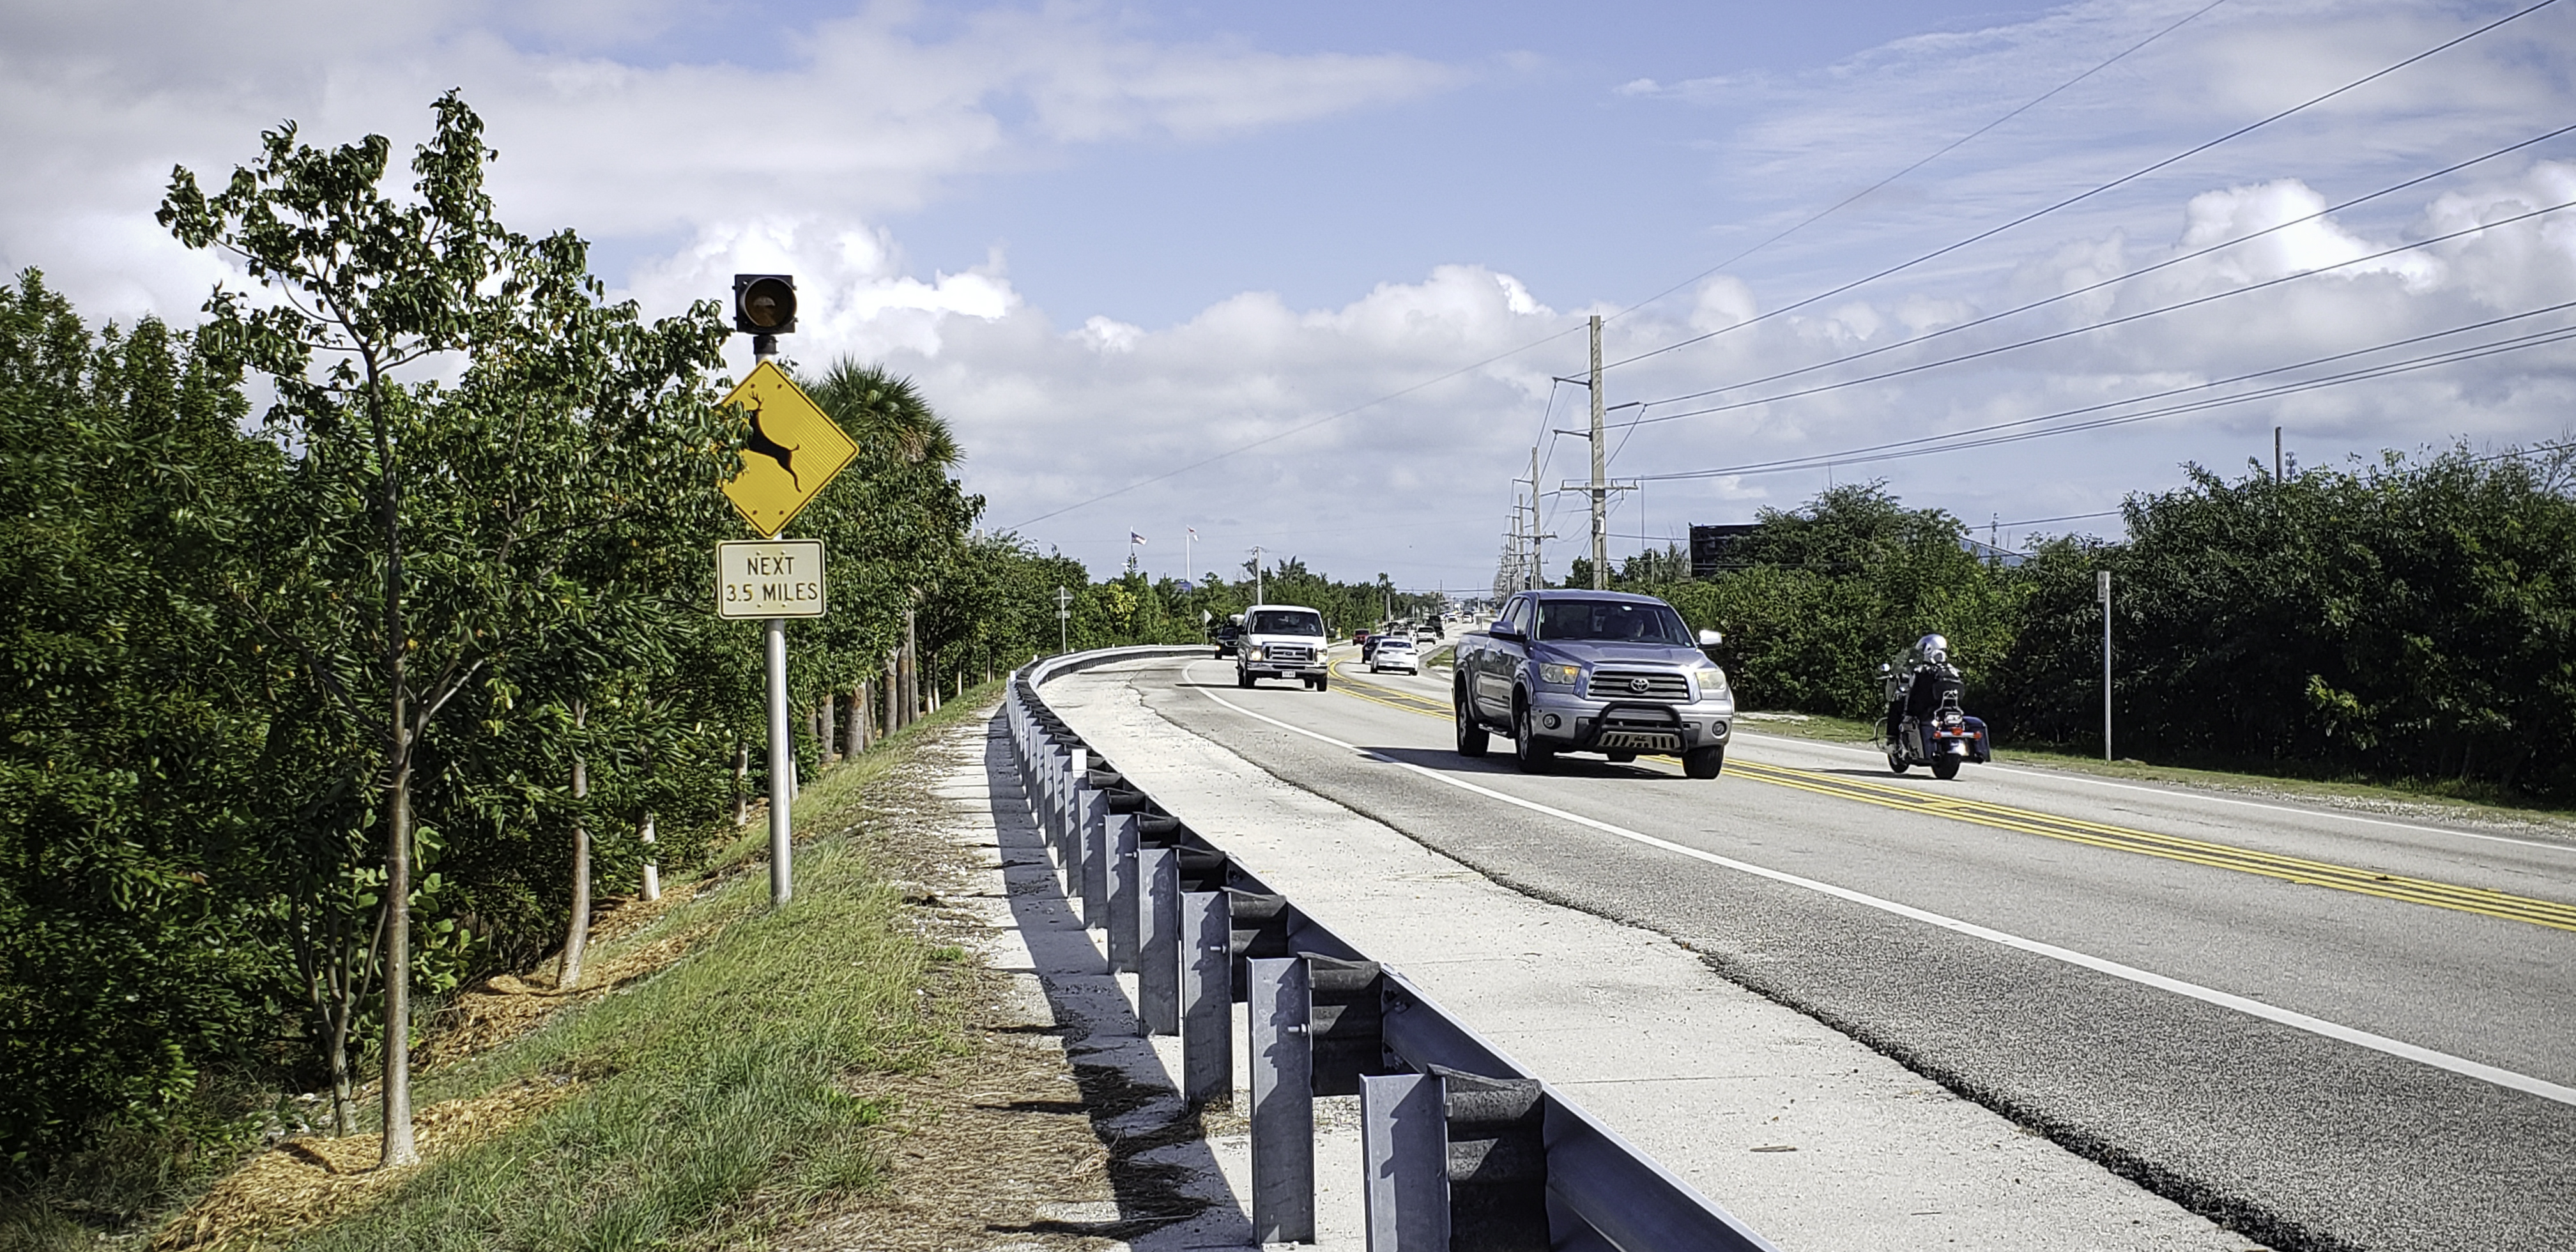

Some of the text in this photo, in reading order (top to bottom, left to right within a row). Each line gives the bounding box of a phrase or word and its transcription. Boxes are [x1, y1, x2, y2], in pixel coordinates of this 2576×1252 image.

[747, 557, 794, 575] NEXT
[726, 583, 818, 601] 3.5 MILES
